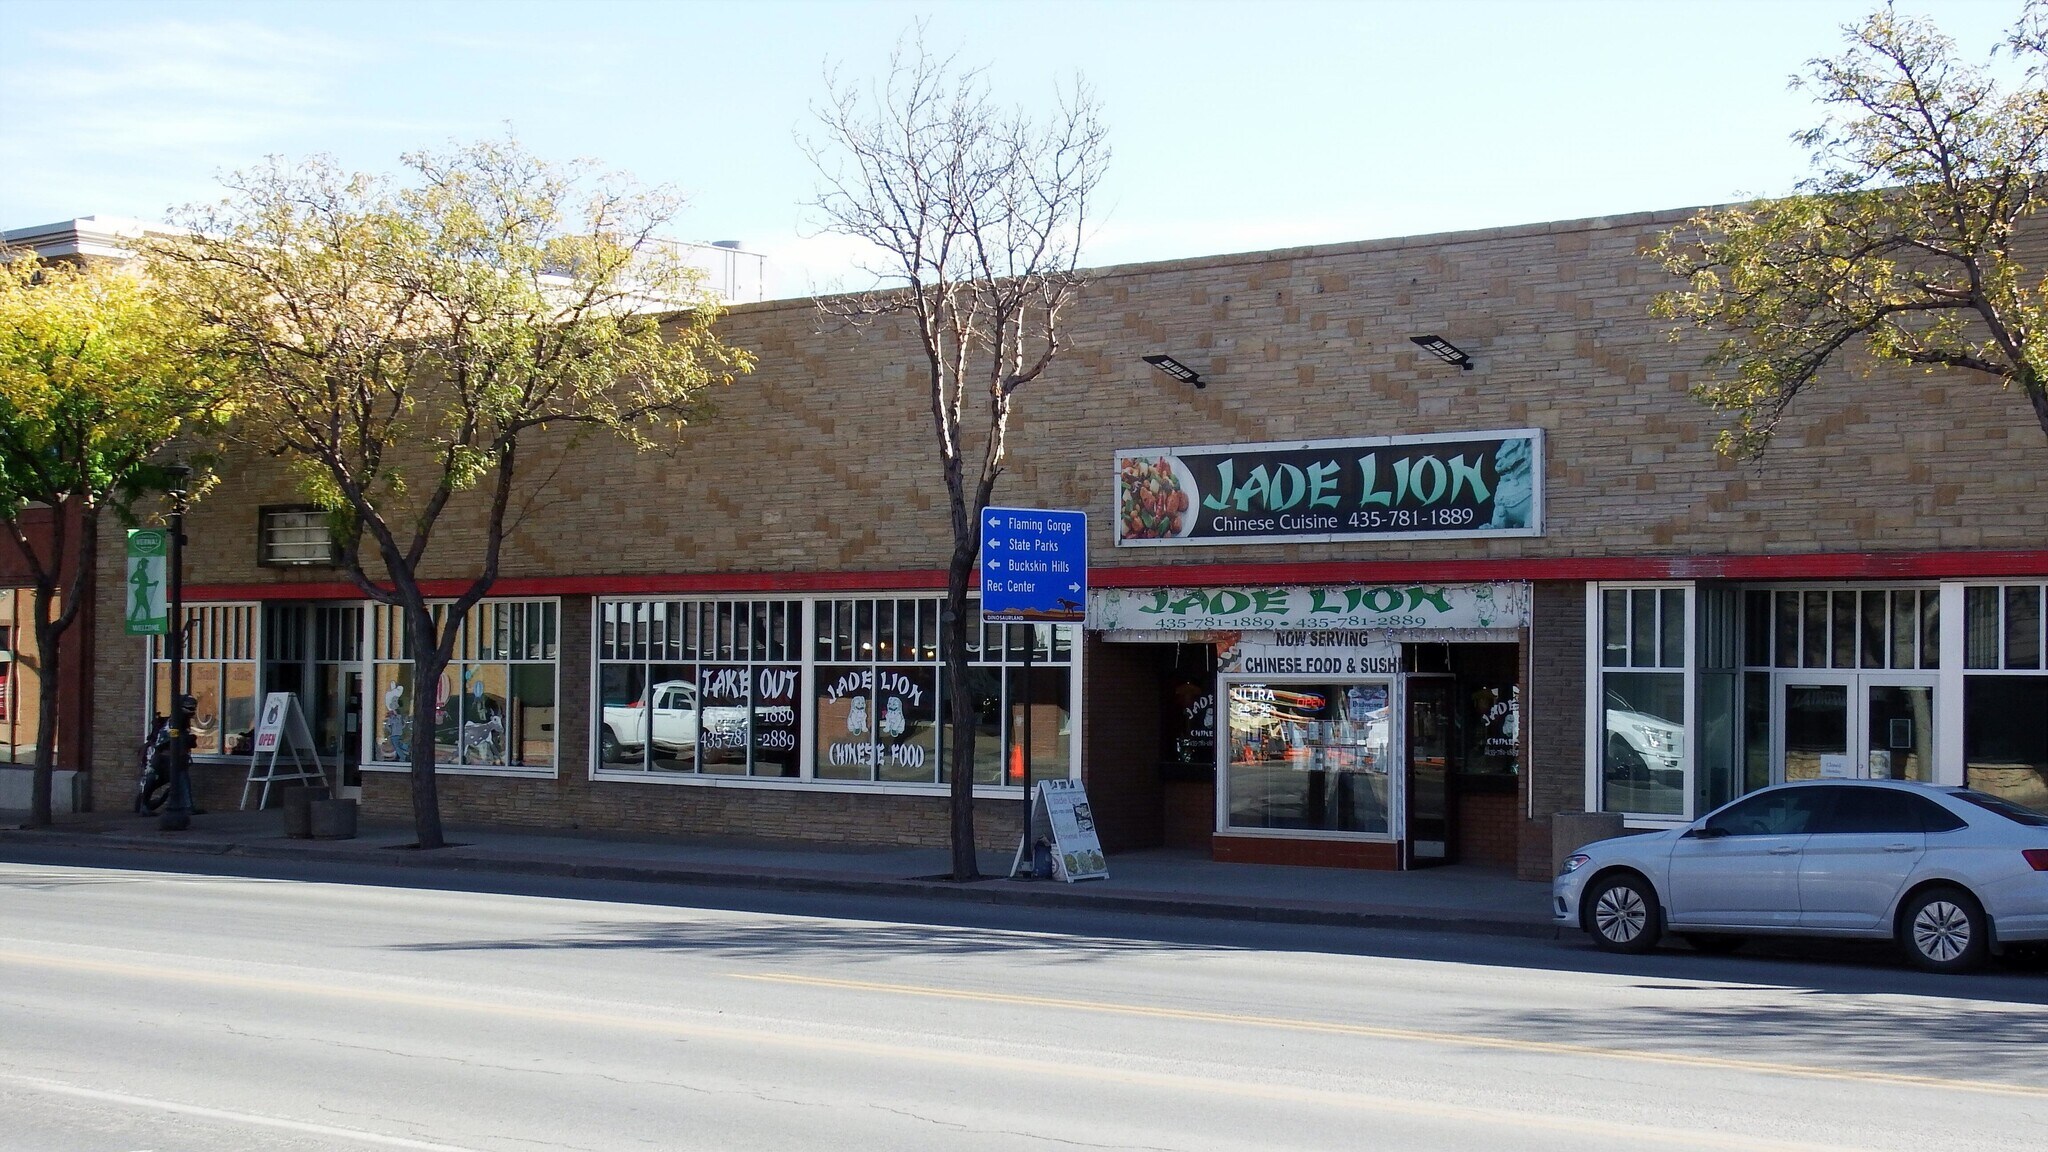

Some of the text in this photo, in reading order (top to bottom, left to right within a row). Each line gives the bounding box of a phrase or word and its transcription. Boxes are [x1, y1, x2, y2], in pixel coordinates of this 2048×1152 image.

[1202, 452, 1491, 512] JADE LION
[1008, 517, 1072, 535] Flaming Gorge
[1212, 508, 1474, 532] Chinese Cuisine 435-781-1889
[1009, 538, 1059, 552] State Parks
[1008, 559, 1070, 573] Buckskin Hills
[987, 579, 1036, 593] Rec Center
[1138, 585, 1455, 616] JADE LION
[132, 623, 161, 632] WELCOME
[1155, 614, 1427, 629] 435-781-1889 435-781-2889
[1275, 630, 1369, 648] NOW SERVING
[1245, 656, 1302, 673] CHINESE
[1305, 656, 1342, 673] FOOD
[1346, 656, 1356, 673] &
[702, 667, 799, 699] TAKE OUT
[827, 670, 923, 707] JADE LION
[1234, 688, 1276, 701] ULTRA
[1296, 697, 1326, 708] OPEN
[258, 733, 277, 746] OPEN
[829, 742, 926, 768] CHINESE FOOD
